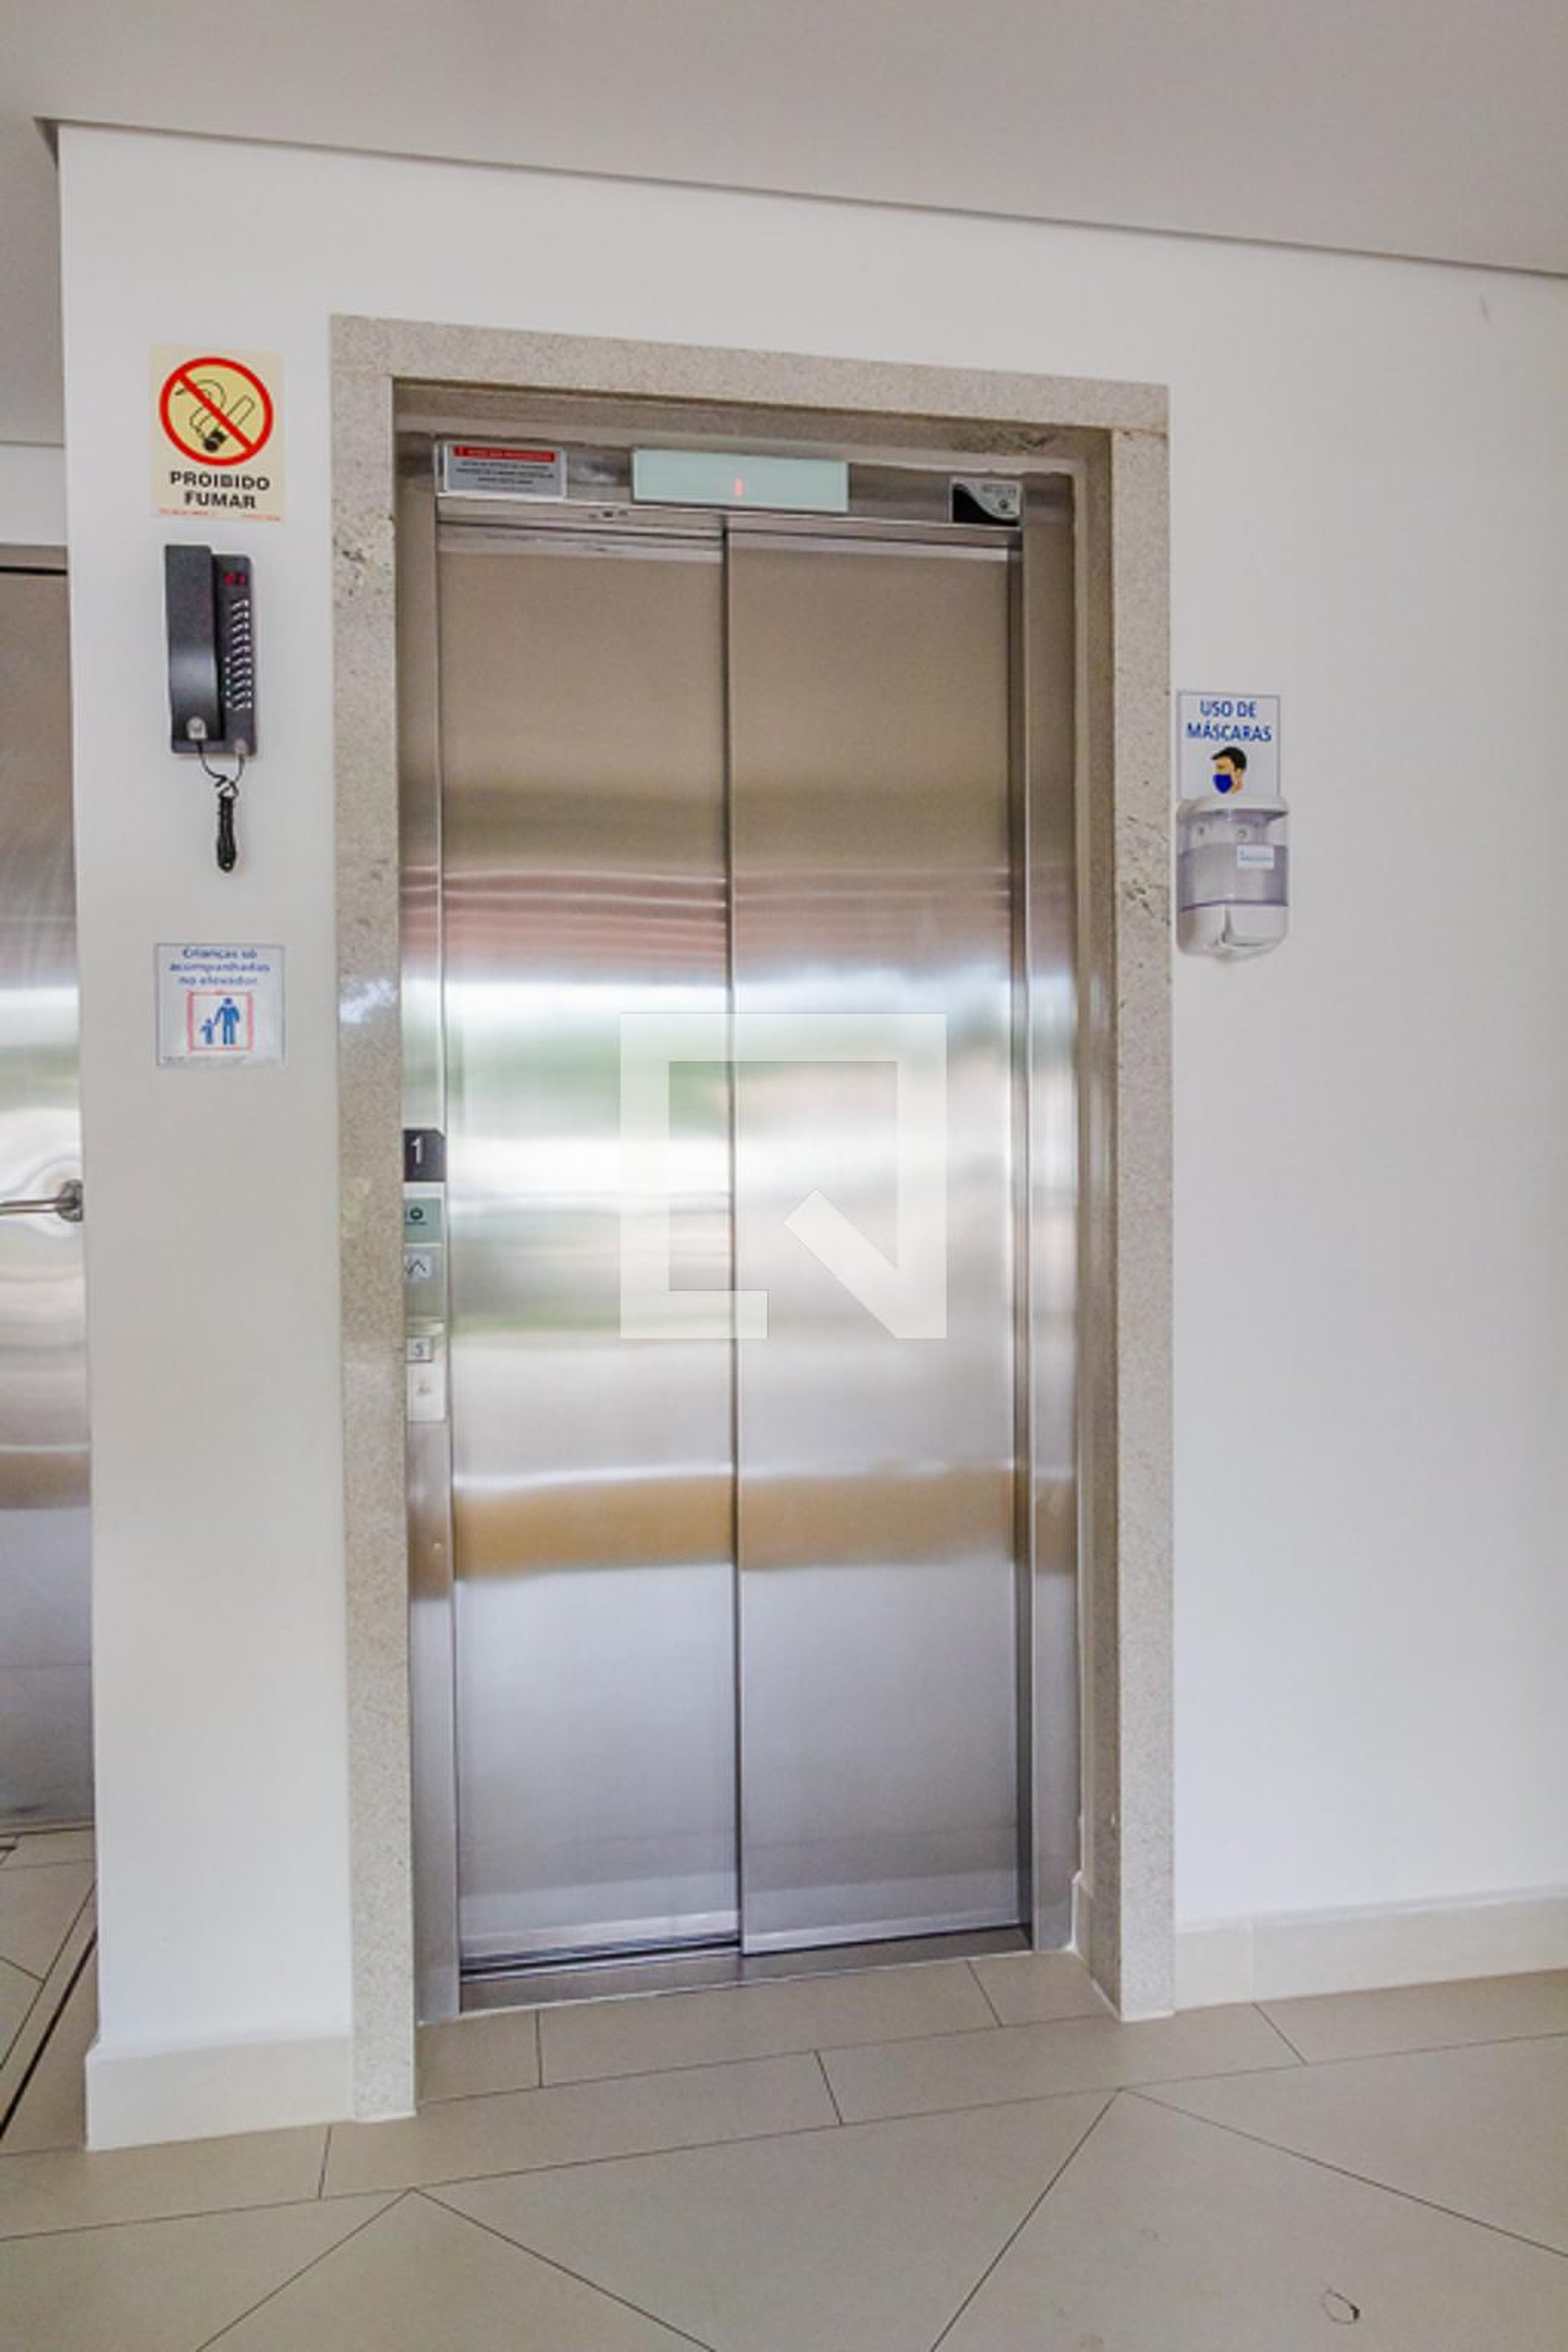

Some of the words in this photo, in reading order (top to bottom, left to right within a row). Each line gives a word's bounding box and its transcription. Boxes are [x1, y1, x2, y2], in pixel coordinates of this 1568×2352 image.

[170, 470, 270, 491] PROIBIDO
[185, 492, 256, 509] FUMAR
[1200, 699, 1233, 717] USO
[1237, 701, 1256, 717] DE
[1187, 720, 1272, 742] MÁSCARAS
[410, 1137, 422, 1164] 1
